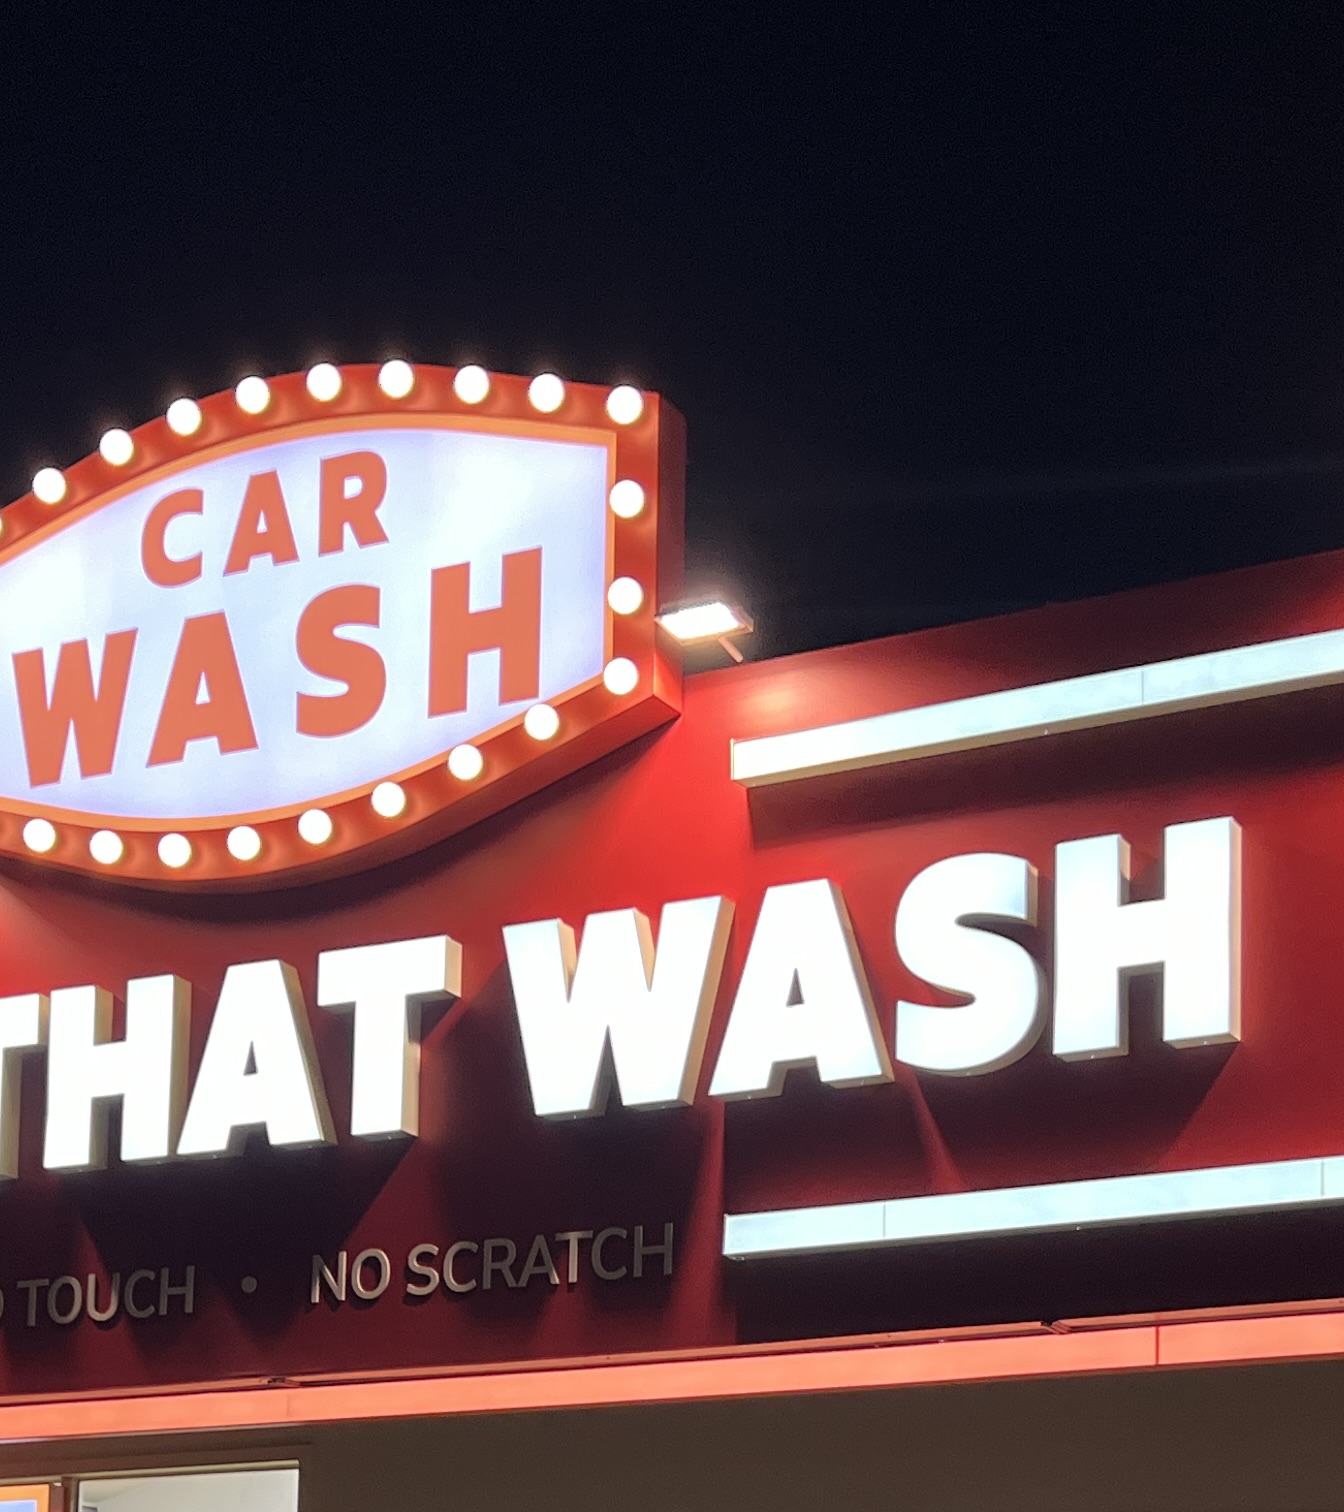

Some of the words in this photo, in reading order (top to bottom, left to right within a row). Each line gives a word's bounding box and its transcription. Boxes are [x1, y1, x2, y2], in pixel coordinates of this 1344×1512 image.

[141, 449, 390, 588] CAR
[12, 546, 543, 789] WASH
[502, 815, 1243, 1122] WASH
[15, 1264, 197, 1326] TOUCH
[311, 1247, 391, 1305] NO
[404, 1222, 675, 1300] SCRATCH
